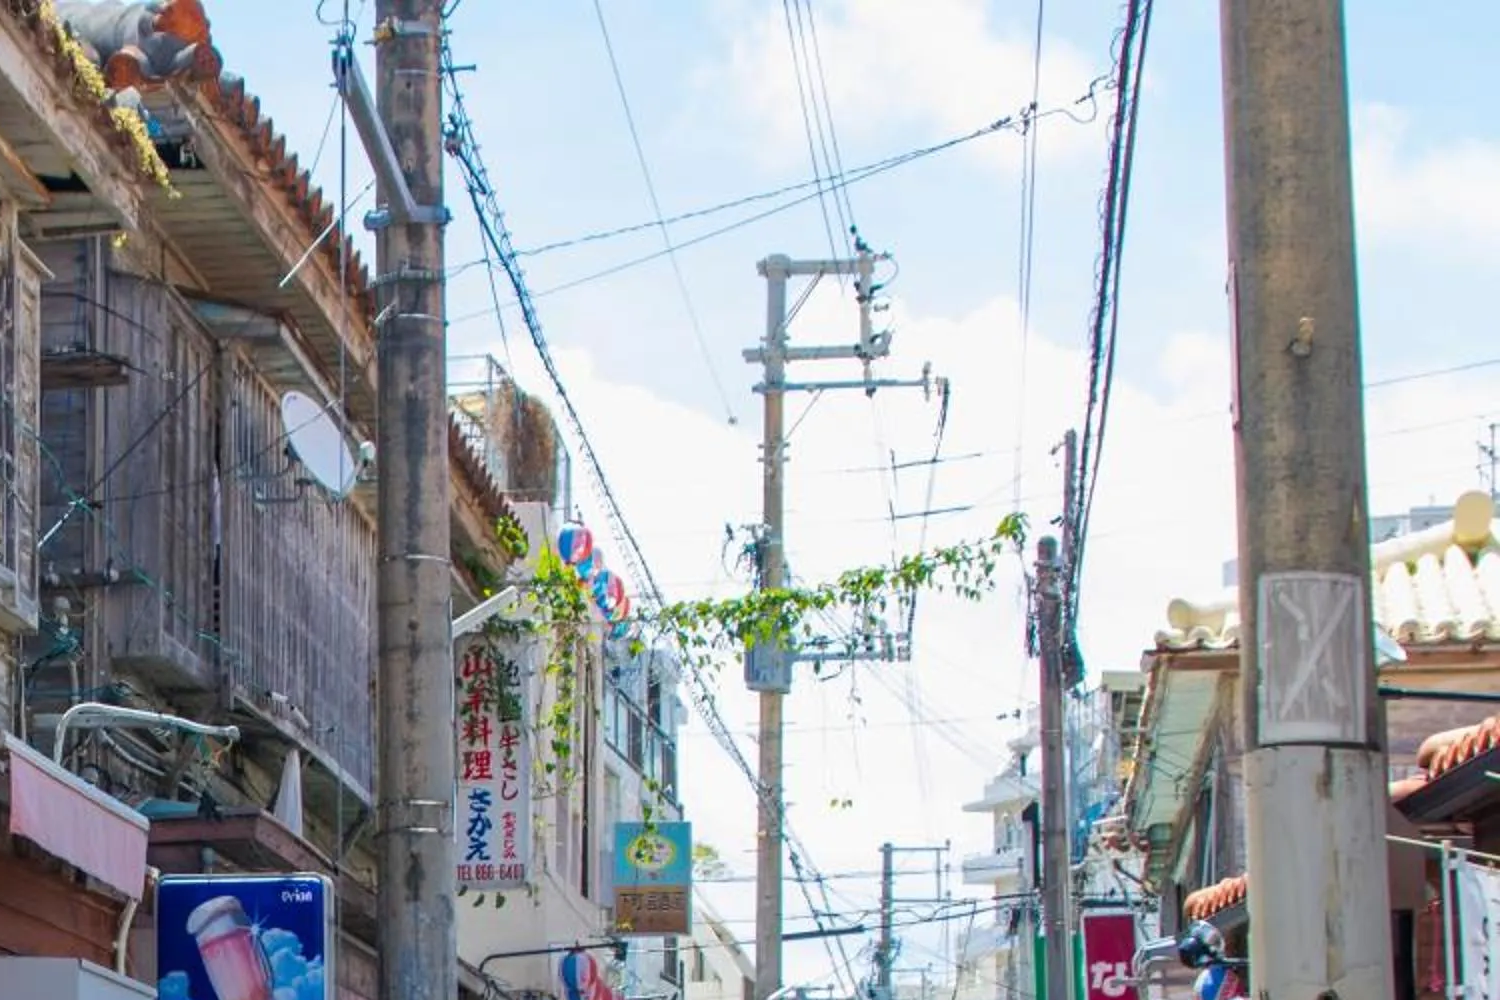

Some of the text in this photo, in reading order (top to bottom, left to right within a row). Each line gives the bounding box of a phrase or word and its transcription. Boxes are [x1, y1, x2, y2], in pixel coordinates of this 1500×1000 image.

[466, 788, 493, 861] さかえ
[456, 864, 473, 881] TEL
[280, 888, 313, 903] Orion
